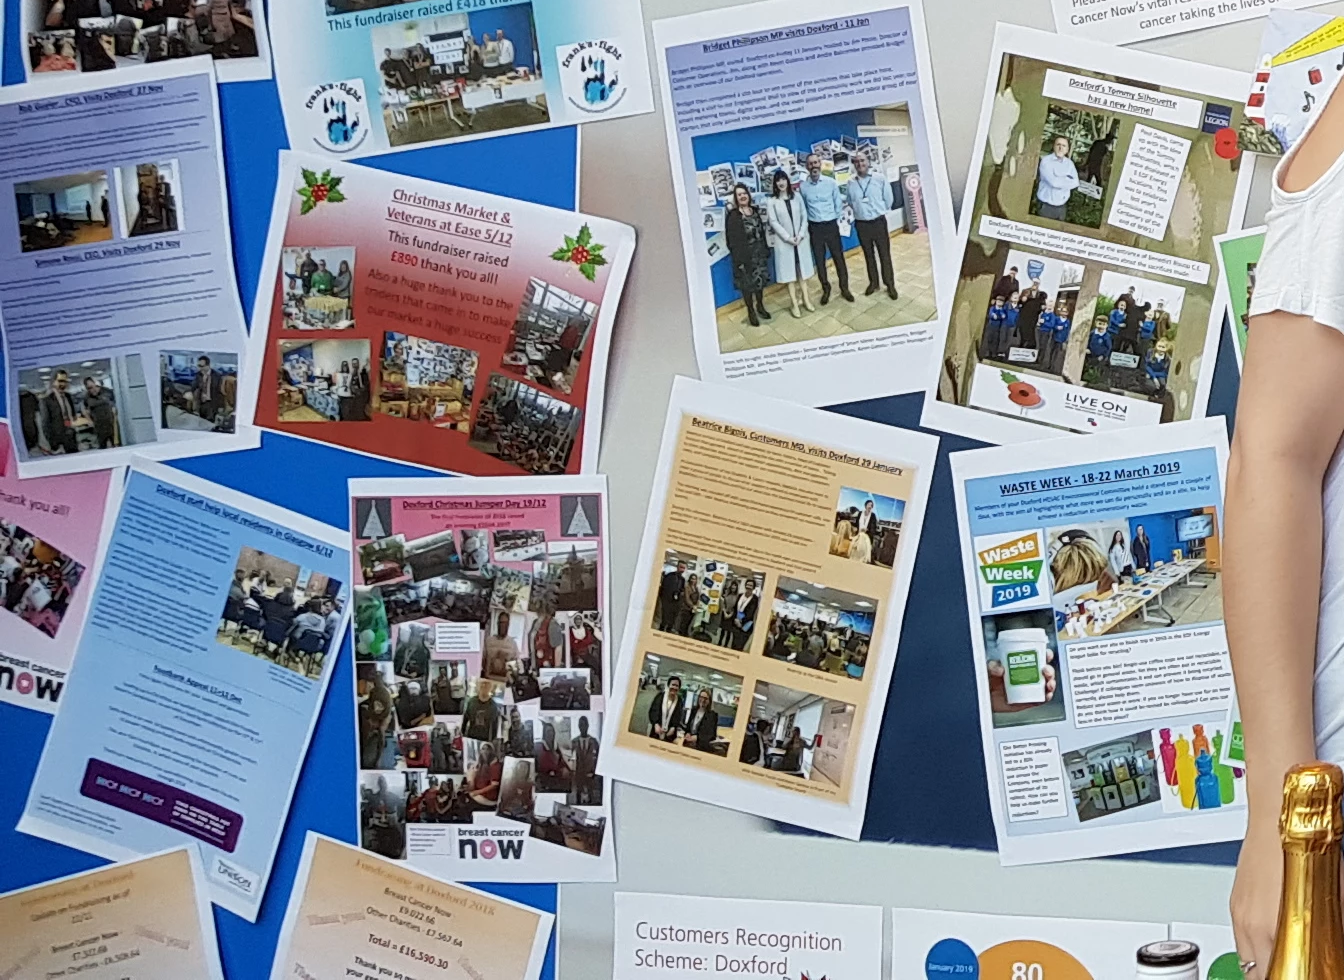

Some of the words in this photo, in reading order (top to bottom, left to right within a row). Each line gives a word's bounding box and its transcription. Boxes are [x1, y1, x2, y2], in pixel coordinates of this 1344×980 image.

[327, 13, 352, 31] This
[354, 8, 413, 26] fundraiser
[417, 0, 453, 17] raised
[392, 189, 451, 211] Christmas
[454, 201, 499, 221] Market
[500, 211, 511, 224] &
[386, 206, 437, 229] Veterans
[439, 220, 452, 232] at
[454, 221, 482, 238] Ease
[483, 228, 513, 245] 5/12
[1066, 393, 1099, 407] LIVE
[1102, 401, 1128, 414] ON
[999, 480, 1037, 493] WASTE
[1039, 475, 1071, 488] WEEK
[1081, 470, 1111, 483] 18-22
[1114, 465, 1149, 479] March
[1152, 461, 1180, 474] 2019
[983, 540, 1035, 564] Waste
[985, 566, 1034, 581] Week
[996, 585, 1031, 601] 2019
[458, 828, 489, 836] breast
[458, 839, 524, 860] now
[635, 921, 728, 944] Customers
[736, 928, 841, 952] Recognition
[634, 948, 707, 970] Scheme:
[715, 954, 787, 978] Doxford
[1011, 962, 1043, 980] 80
